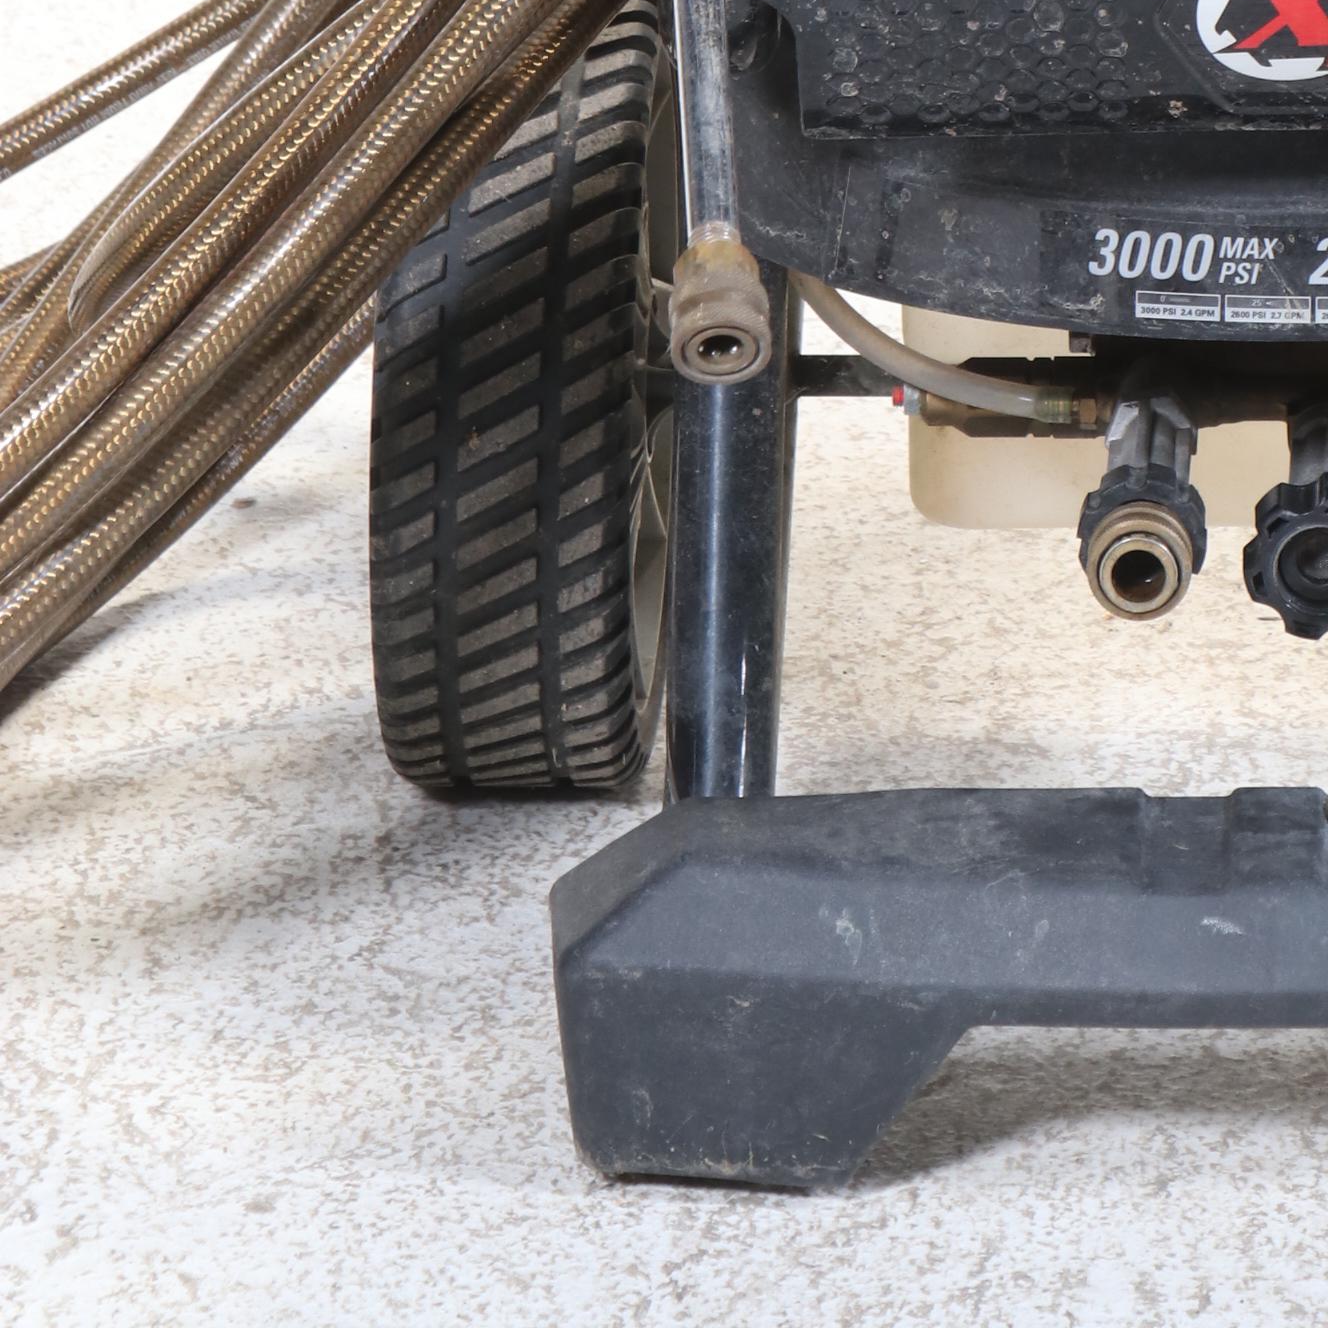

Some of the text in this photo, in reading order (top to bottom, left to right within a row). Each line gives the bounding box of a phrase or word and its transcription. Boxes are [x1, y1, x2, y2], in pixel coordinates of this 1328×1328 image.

[1088, 228, 1279, 282] 3000 MAX
[1218, 262, 1262, 285] PSI
[1140, 306, 1215, 318] 3000 PSI 2.4 GPM
[1230, 311, 1251, 319] 2600
[1252, 311, 1267, 319] PSI
[1270, 311, 1282, 319] 2.7
